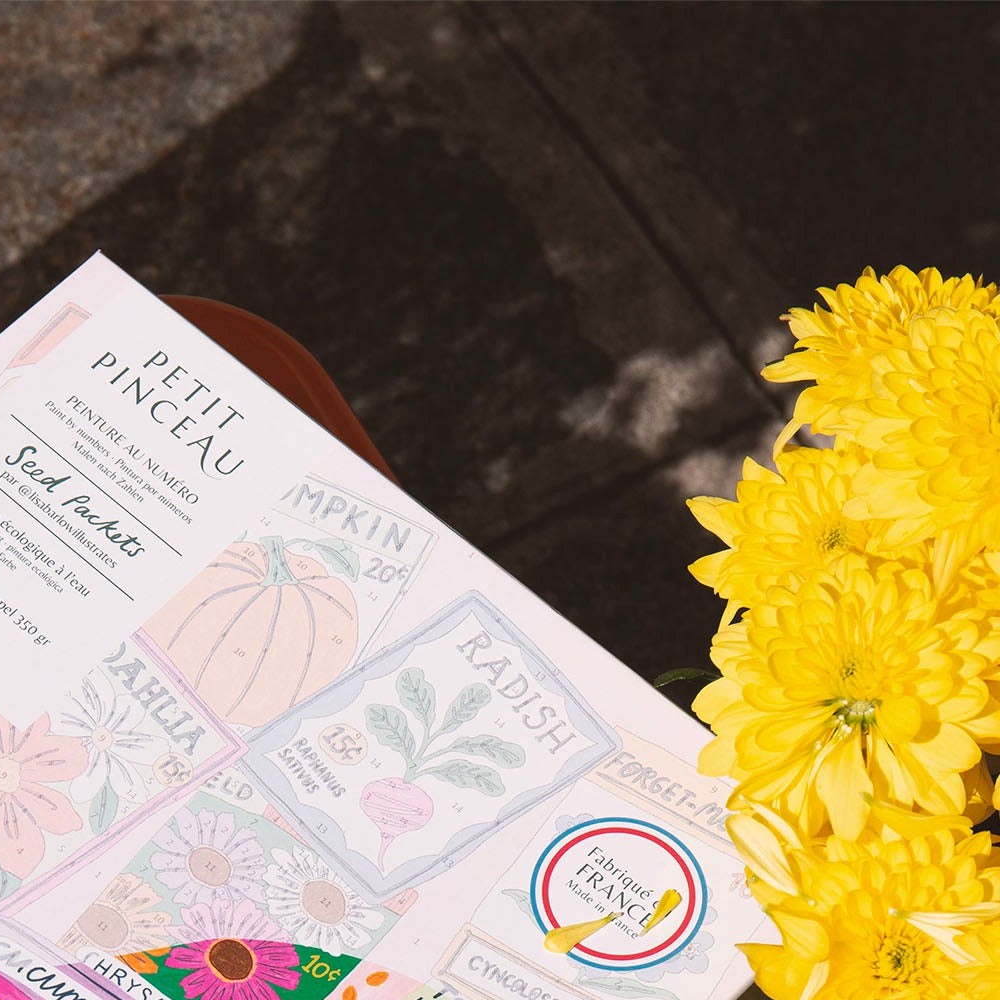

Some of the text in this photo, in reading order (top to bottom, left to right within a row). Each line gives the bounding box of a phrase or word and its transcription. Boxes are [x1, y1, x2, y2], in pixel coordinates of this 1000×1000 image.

[91, 352, 244, 479] PINCEAU
[143, 351, 244, 429] PETIT
[0, 470, 20, 488] par
[45, 400, 193, 525] Paint by numbers Pintura por números
[66, 395, 199, 505] PEINTURE AU NUMÉRO
[72, 440, 144, 503] Malen nach Zahlen
[5, 446, 145, 557] Seed Packets
[0, 519, 56, 568] écologique
[54, 563, 65, 576] à
[5, 544, 32, 568] pintura
[31, 564, 64, 594] ecológica
[12, 613, 38, 636] 350
[34, 632, 51, 647] gr
[456, 630, 577, 755] RADISH
[277, 748, 320, 795] SATIVUS
[294, 736, 347, 799] RAPHANUS
[566, 880, 593, 904] Made
[594, 901, 605, 914] in
[576, 863, 653, 928] FRANCE
[587, 846, 654, 900] Fabriqué
[301, 954, 342, 982] 10¢
